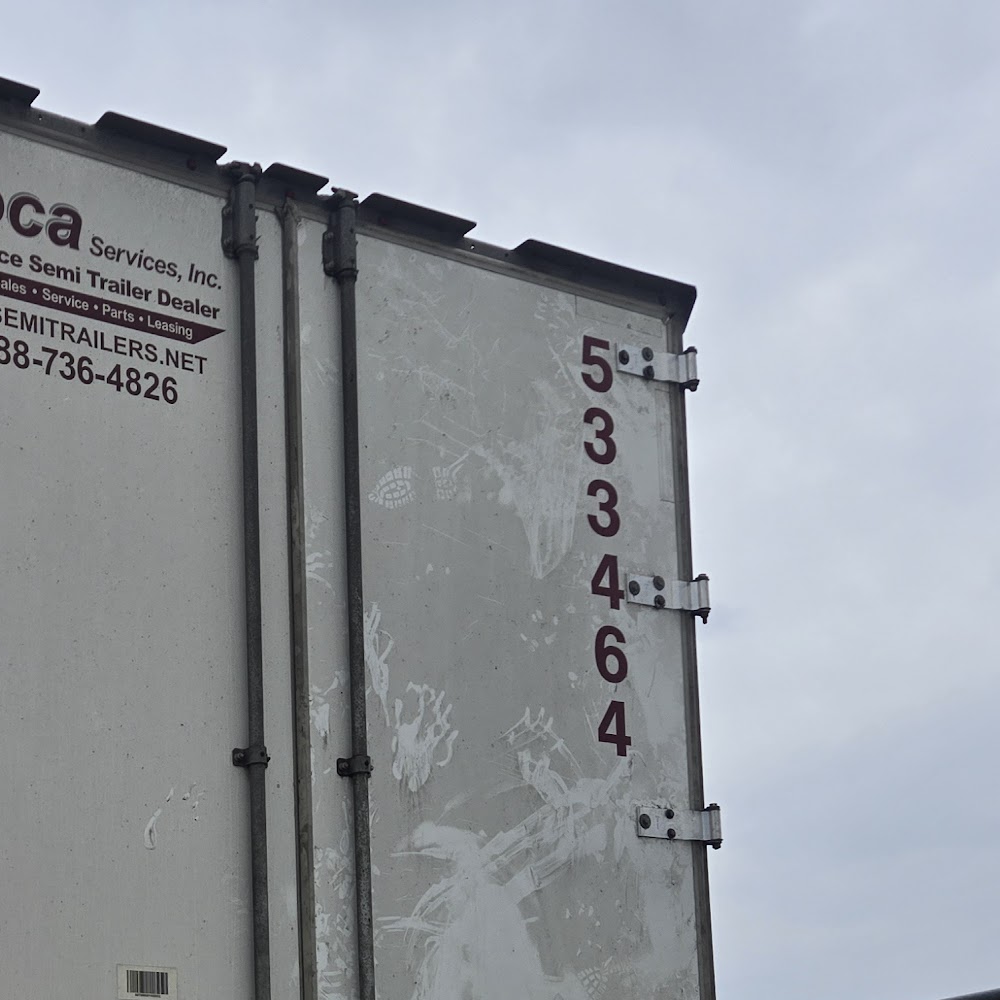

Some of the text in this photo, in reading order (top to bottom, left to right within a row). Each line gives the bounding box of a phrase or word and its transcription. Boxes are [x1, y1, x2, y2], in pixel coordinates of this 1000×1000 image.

[29, 255, 81, 284] Semi
[86, 269, 153, 302] Trailer
[157, 289, 221, 320] Dealer
[89, 235, 182, 283] Services,
[188, 263, 222, 291] Inc.
[41, 287, 89, 312] Service
[102, 303, 135, 323] Parts
[147, 315, 194, 340] Leasing
